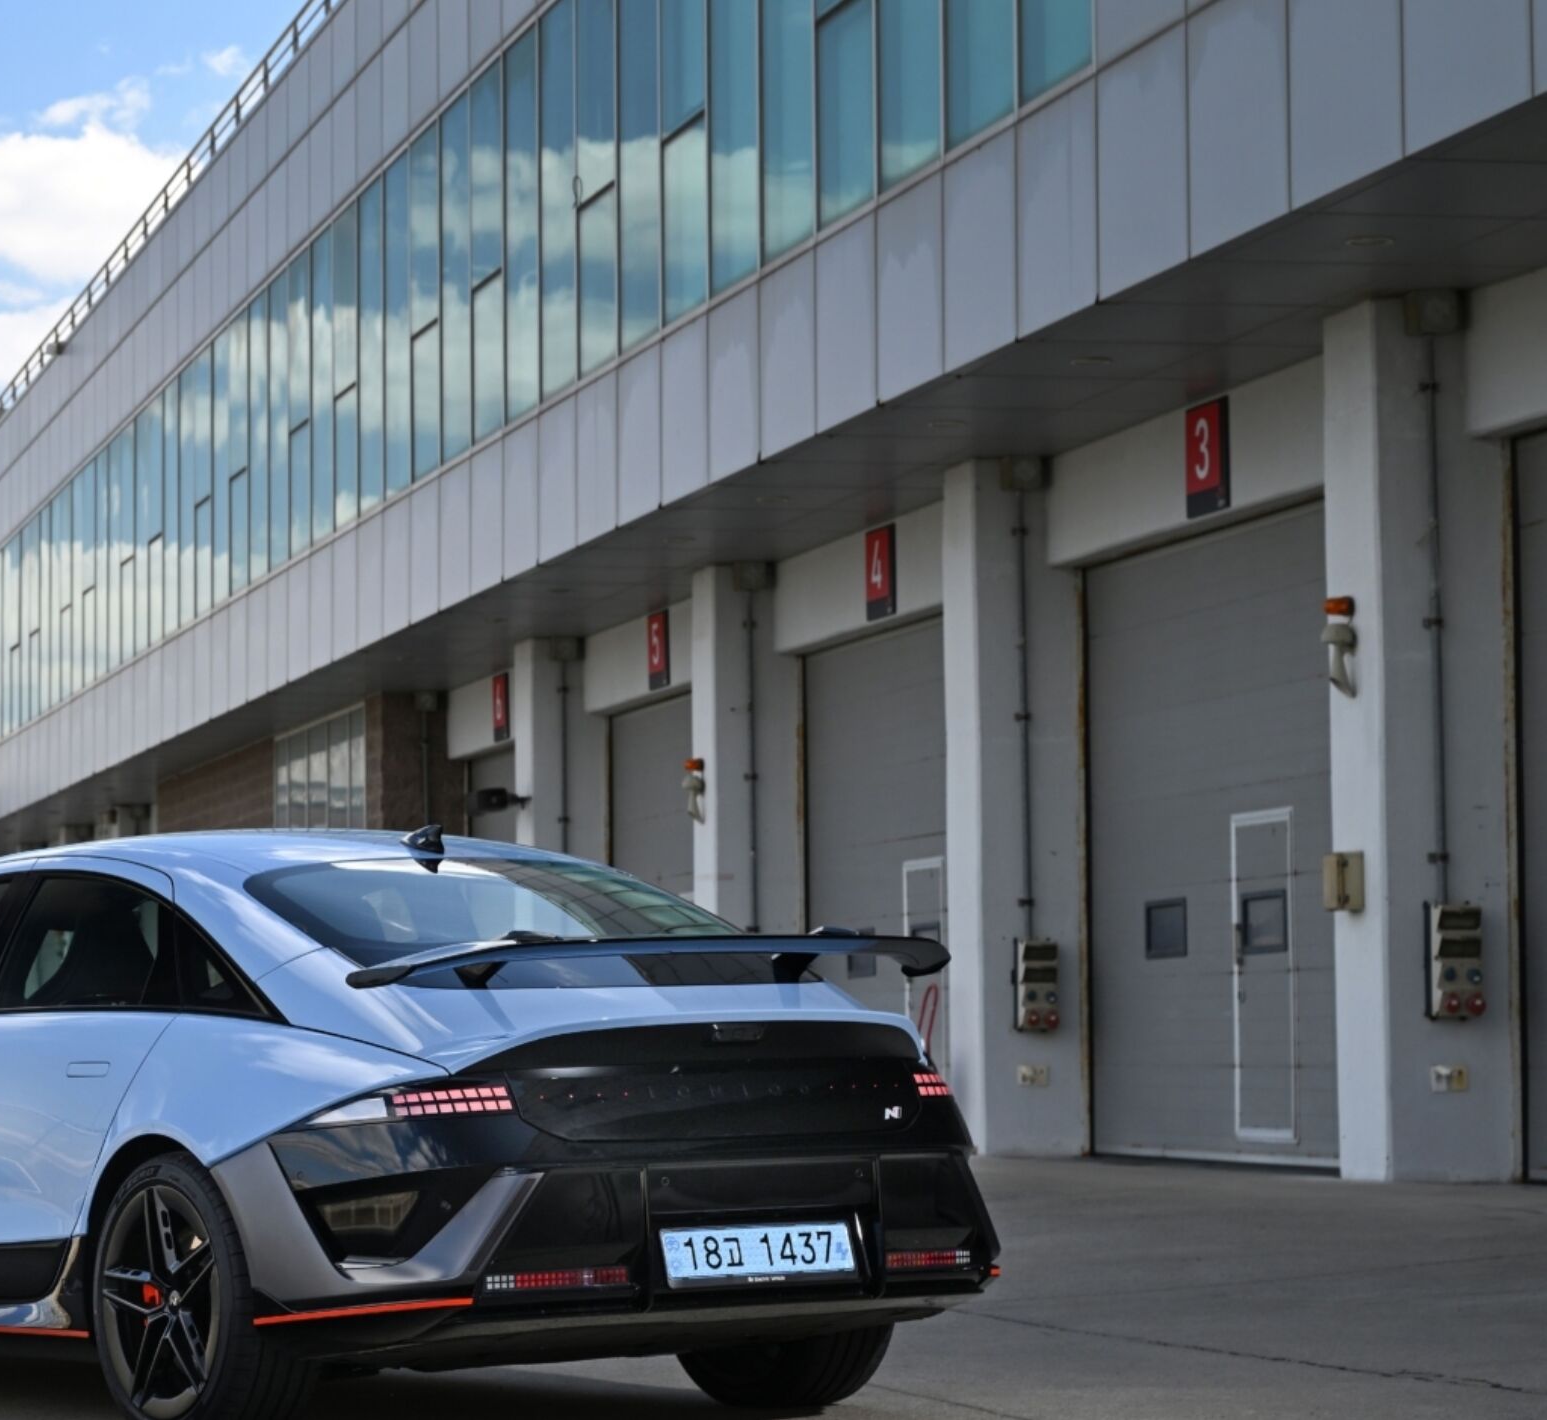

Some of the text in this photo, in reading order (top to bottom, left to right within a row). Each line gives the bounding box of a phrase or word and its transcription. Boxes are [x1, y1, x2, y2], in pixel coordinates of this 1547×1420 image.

[1195, 418, 1210, 480] 3
[871, 539, 882, 590] 4
[651, 622, 660, 665] 5
[495, 683, 503, 720] 6
[884, 1105, 901, 1120] N
[683, 1231, 832, 1270] 18고 1437
